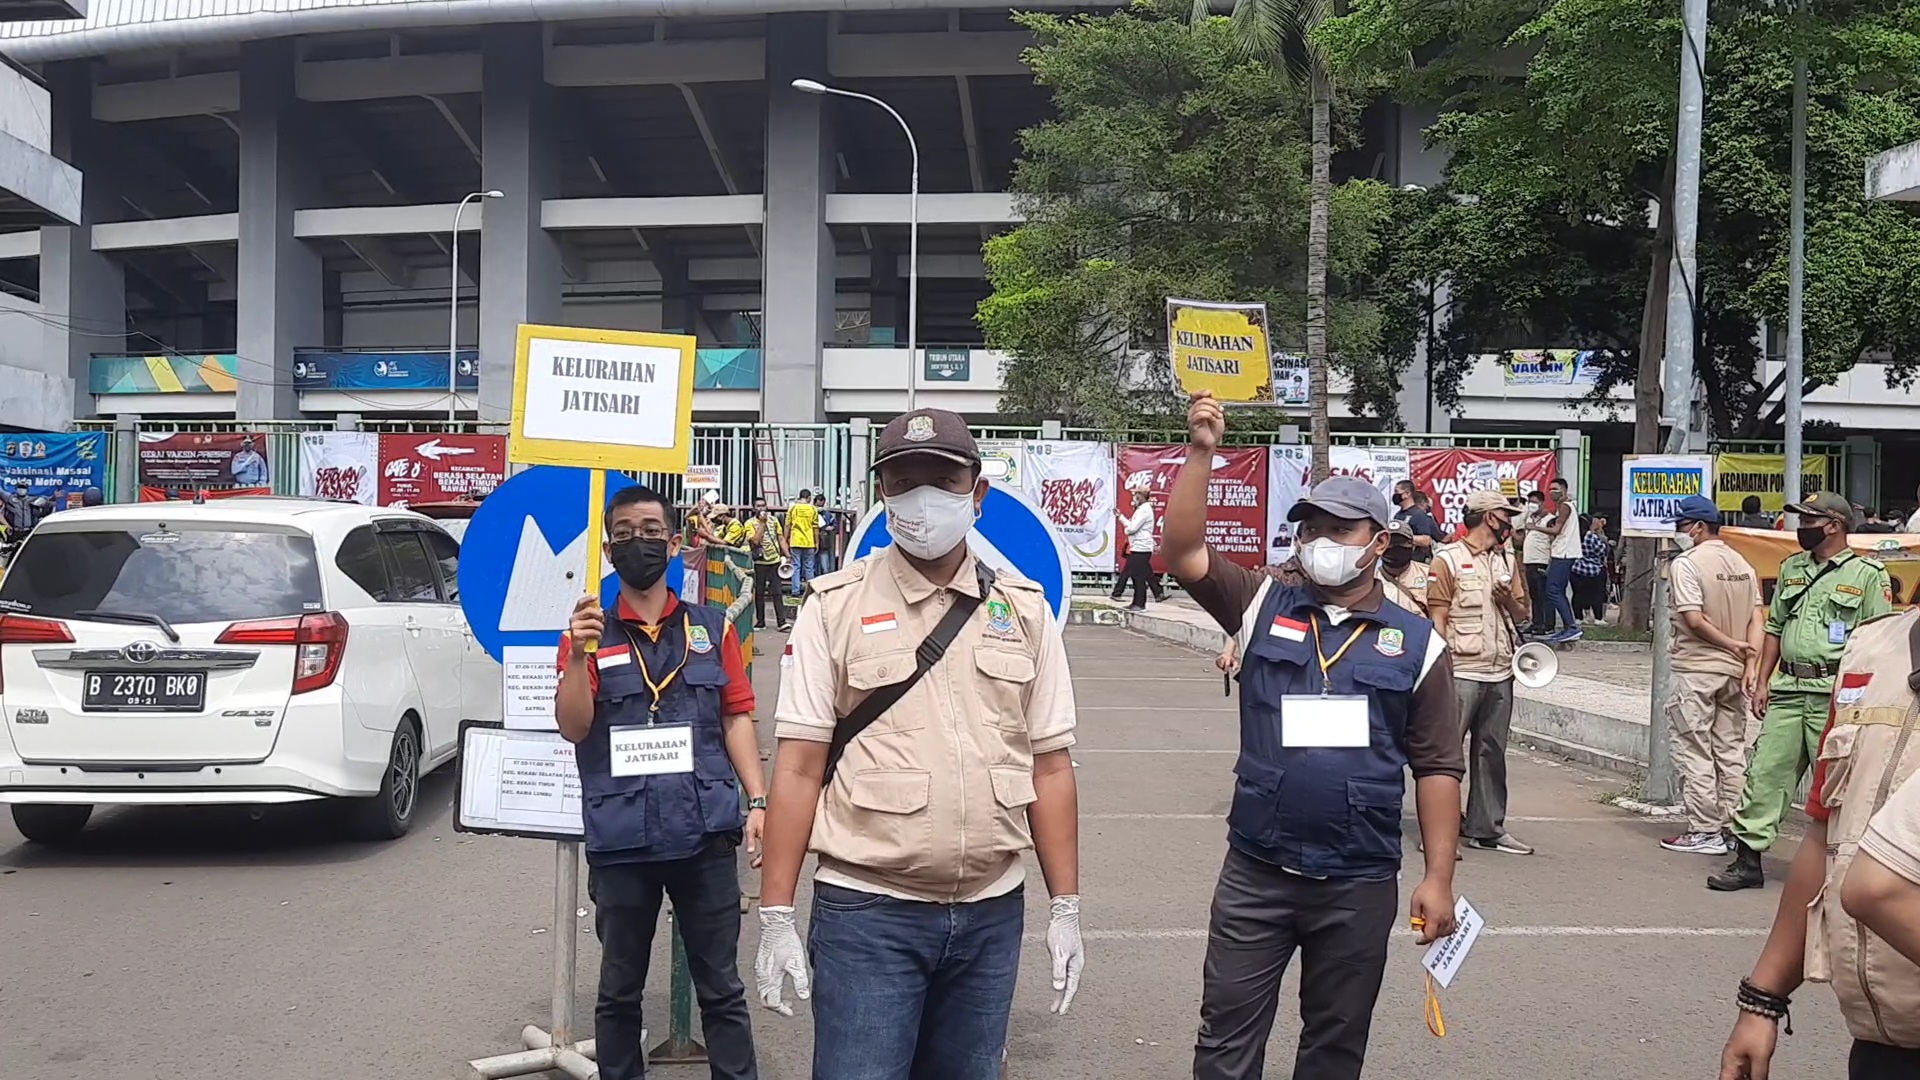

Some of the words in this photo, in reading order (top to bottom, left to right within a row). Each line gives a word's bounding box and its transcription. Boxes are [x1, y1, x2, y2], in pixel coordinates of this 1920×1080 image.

[1176, 331, 1254, 351] KELURAHAN
[929, 353, 947, 361] TRIBUN
[948, 353, 965, 361] UTARA
[552, 356, 656, 383] KELURAHAN
[1187, 355, 1240, 375] JATISARI
[561, 389, 641, 415] JATISARI
[5, 466, 53, 475] Vaksinasi
[57, 466, 92, 476] Massal
[433, 472, 463, 480] BEKASI
[465, 472, 503, 480] SELATAN
[4, 477, 32, 487] Polda
[35, 477, 63, 487] Metro
[67, 477, 92, 488] Jaya
[438, 479, 469, 487] BEKASI
[470, 479, 497, 487] TIMUR
[1157, 471, 1167, 490] 4
[1432, 478, 1539, 494] VAKSINSI
[1633, 472, 1700, 495] KELURAHAN
[1720, 473, 1768, 492] KECAMATAN
[1207, 485, 1223, 493] ASI
[1225, 485, 1258, 493] UTARA
[1225, 492, 1257, 500] BARAT
[1222, 499, 1258, 507] SATRIA
[1206, 527, 1227, 535] DOK
[1225, 536, 1261, 544] MELATI
[90, 676, 101, 695] B
[113, 676, 156, 695] 2370
[16, 708, 48, 717] ASTRA
[615, 739, 688, 753] KELURAHAN
[624, 751, 679, 763] JATISARI
[1443, 921, 1472, 970] JATISARI
